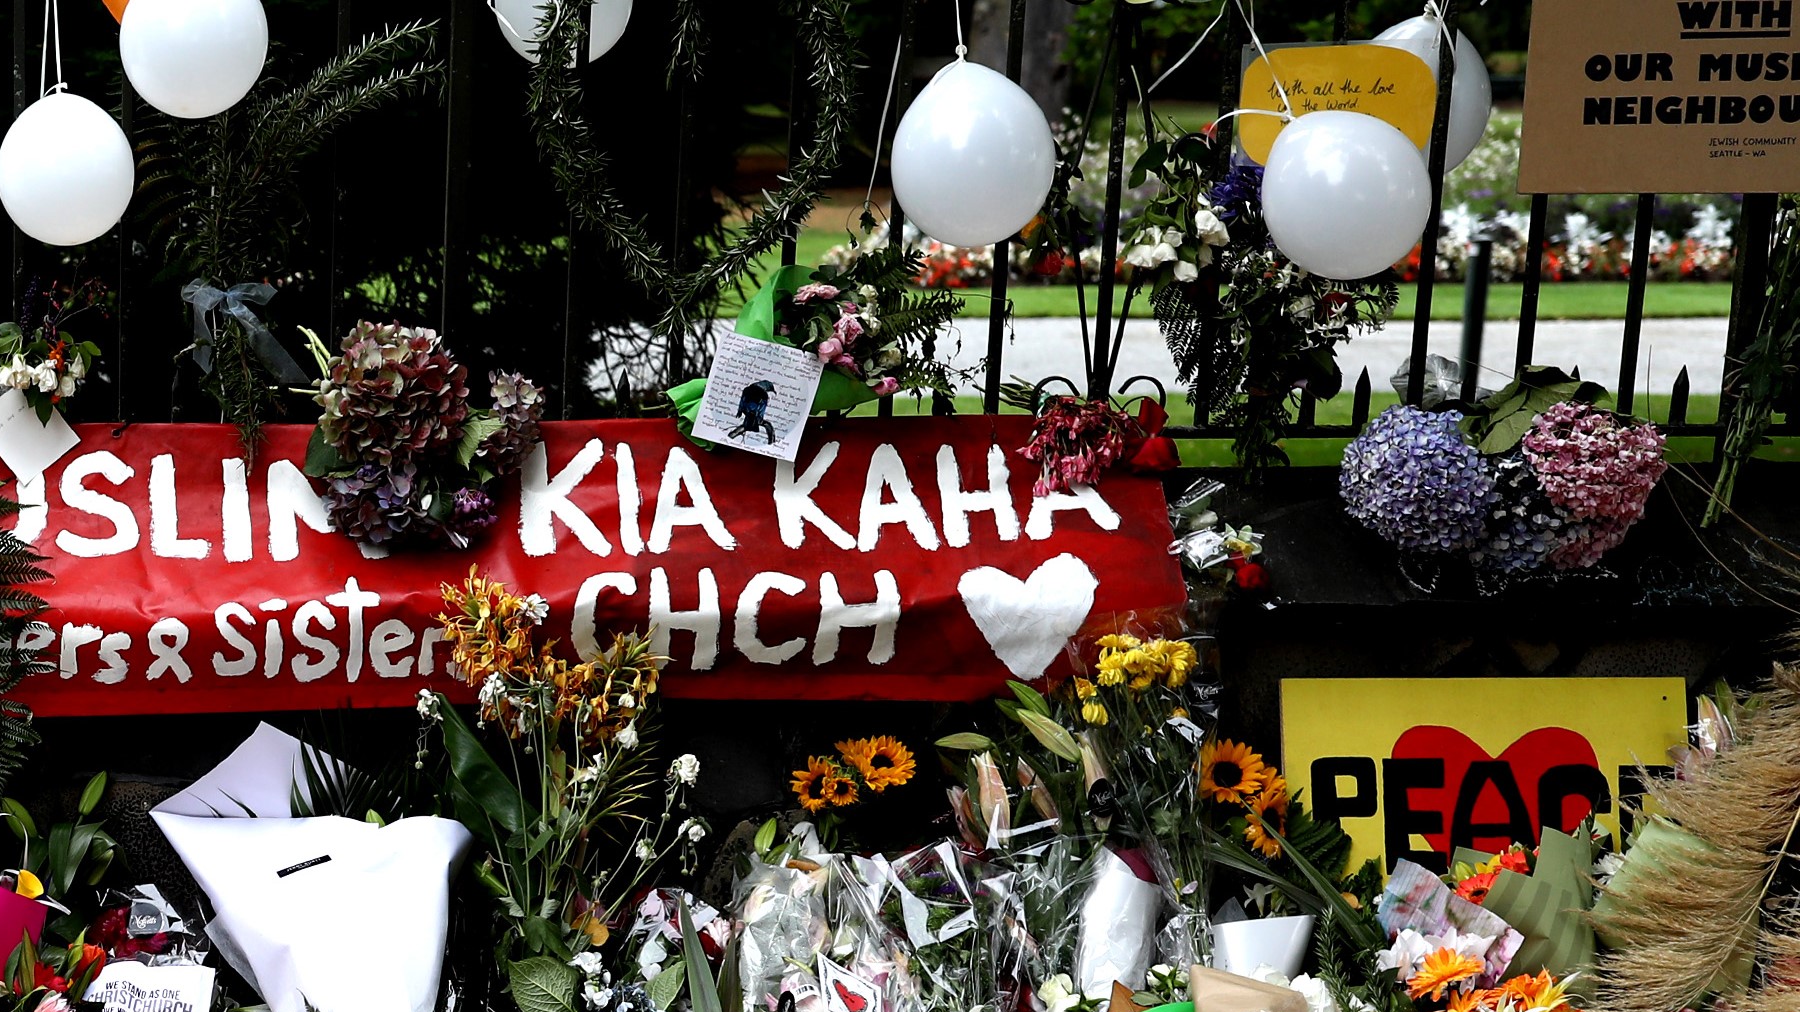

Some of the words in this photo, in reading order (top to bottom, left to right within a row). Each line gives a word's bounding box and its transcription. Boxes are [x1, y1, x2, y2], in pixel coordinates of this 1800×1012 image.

[1677, 1, 1793, 30] WITH
[1585, 53, 1674, 82] OUR
[1313, 82, 1334, 95] all
[1340, 79, 1362, 95] the
[1368, 77, 1397, 95] love
[1302, 99, 1318, 111] the
[1708, 137, 1740, 147] JEWISH
[1742, 136, 1797, 146] COMMUNITY
[1709, 150, 1743, 158] SEATTLE
[519, 437, 738, 557] KIA
[773, 440, 1122, 552] KAHA
[570, 566, 902, 672] CHCH
[145, 617, 193, 684] &
[105, 981, 119, 990] WE
[121, 980, 146, 1000] STAND
[148, 990, 160, 999] AS
[161, 988, 181, 1001] ONE
